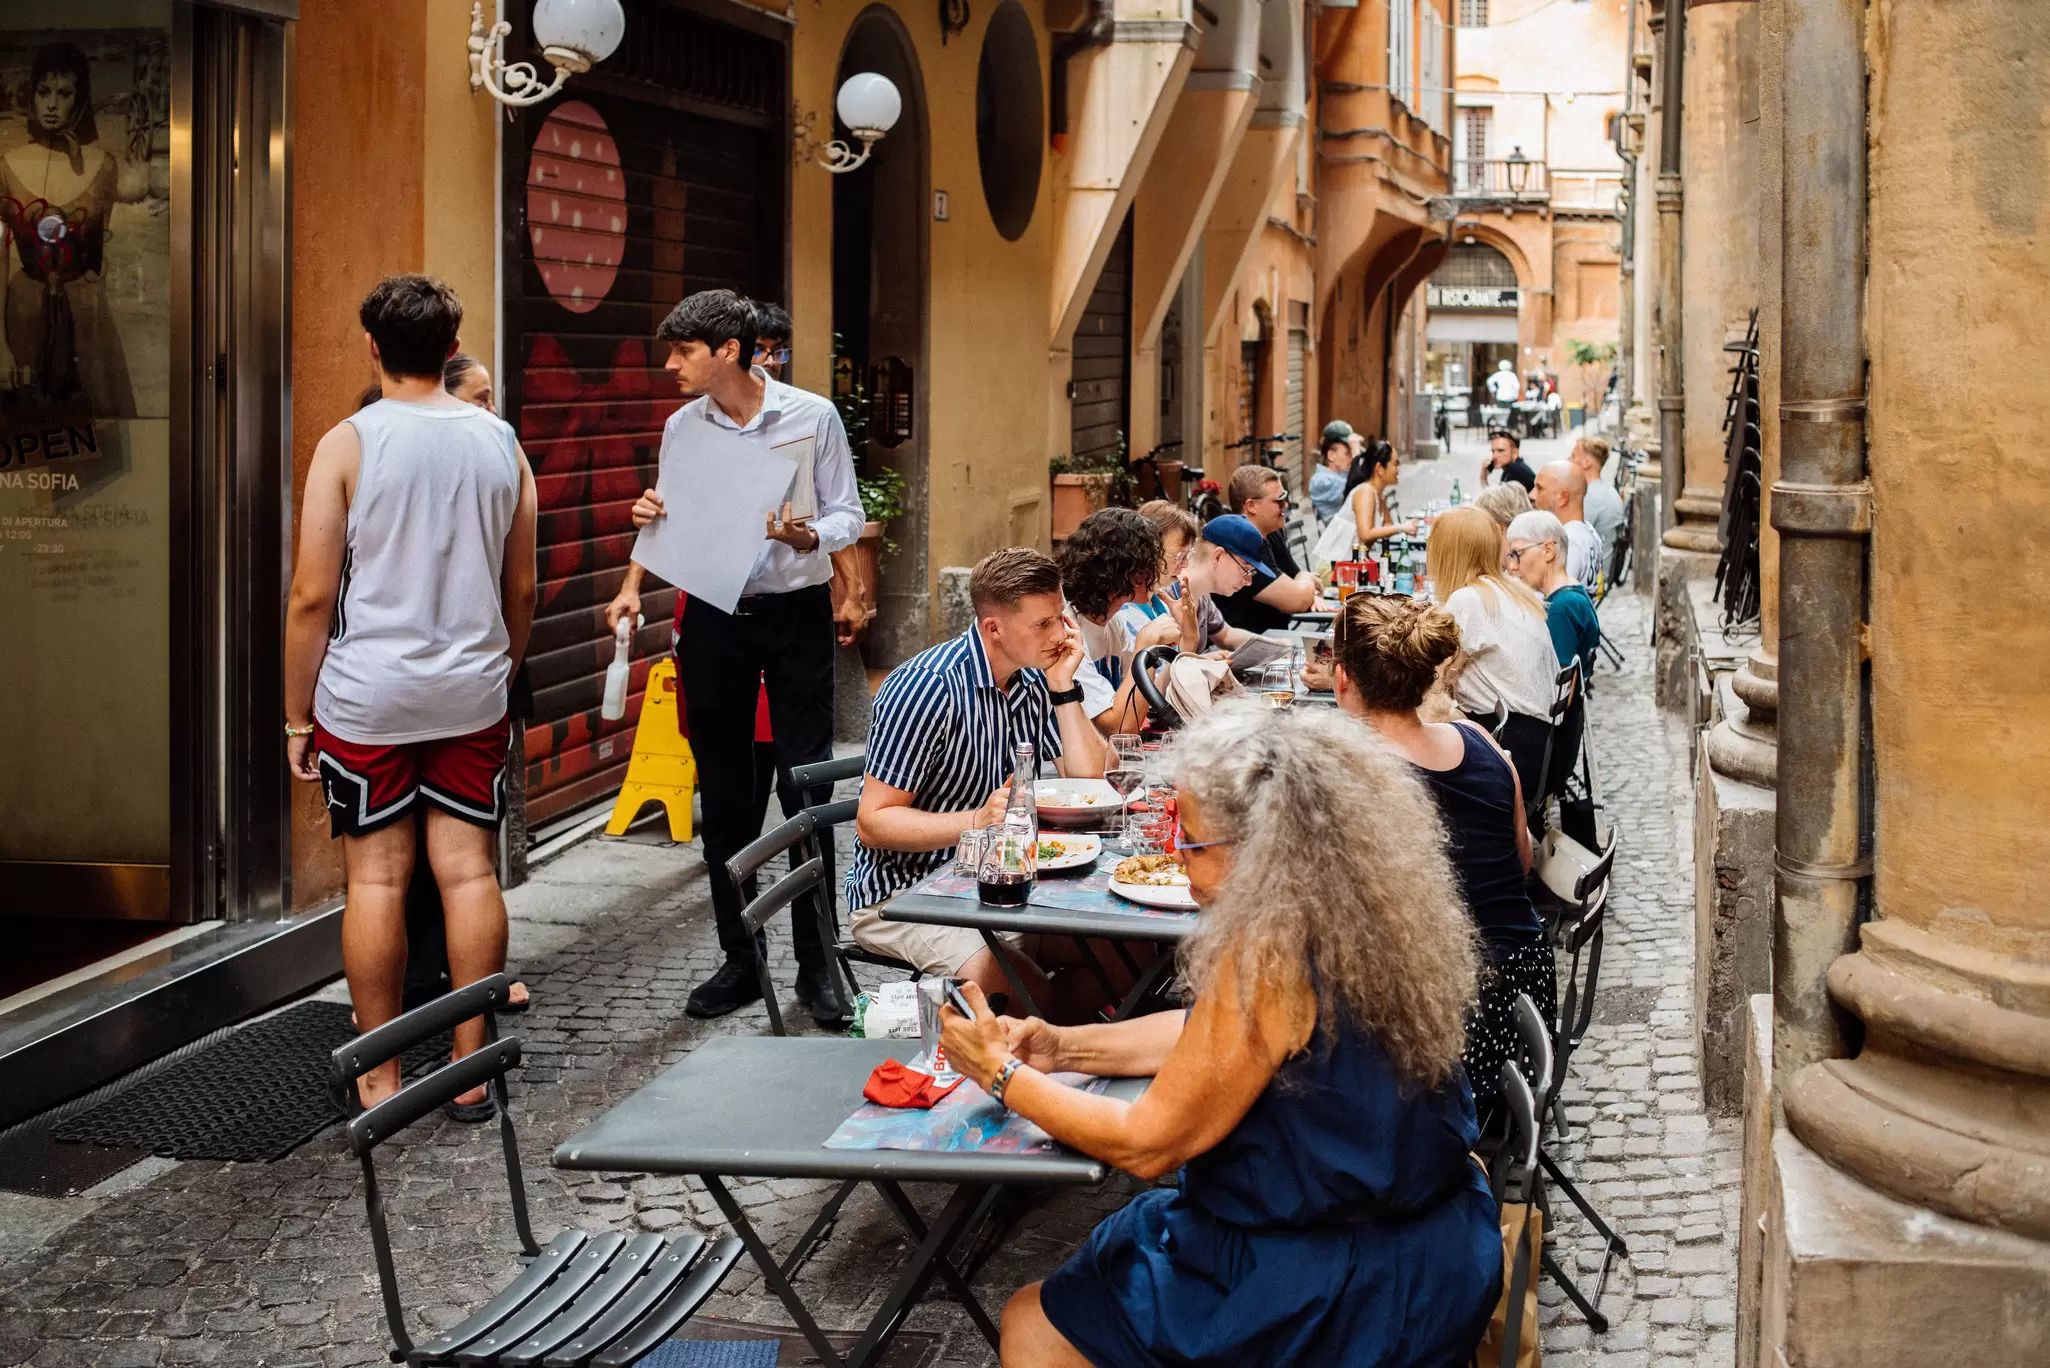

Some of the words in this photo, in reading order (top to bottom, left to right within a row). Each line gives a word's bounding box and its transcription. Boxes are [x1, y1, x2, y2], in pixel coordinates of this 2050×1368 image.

[27, 473, 80, 490] SOFIA
[15, 516, 69, 528] APERTURA
[6, 530, 32, 540] 12:00
